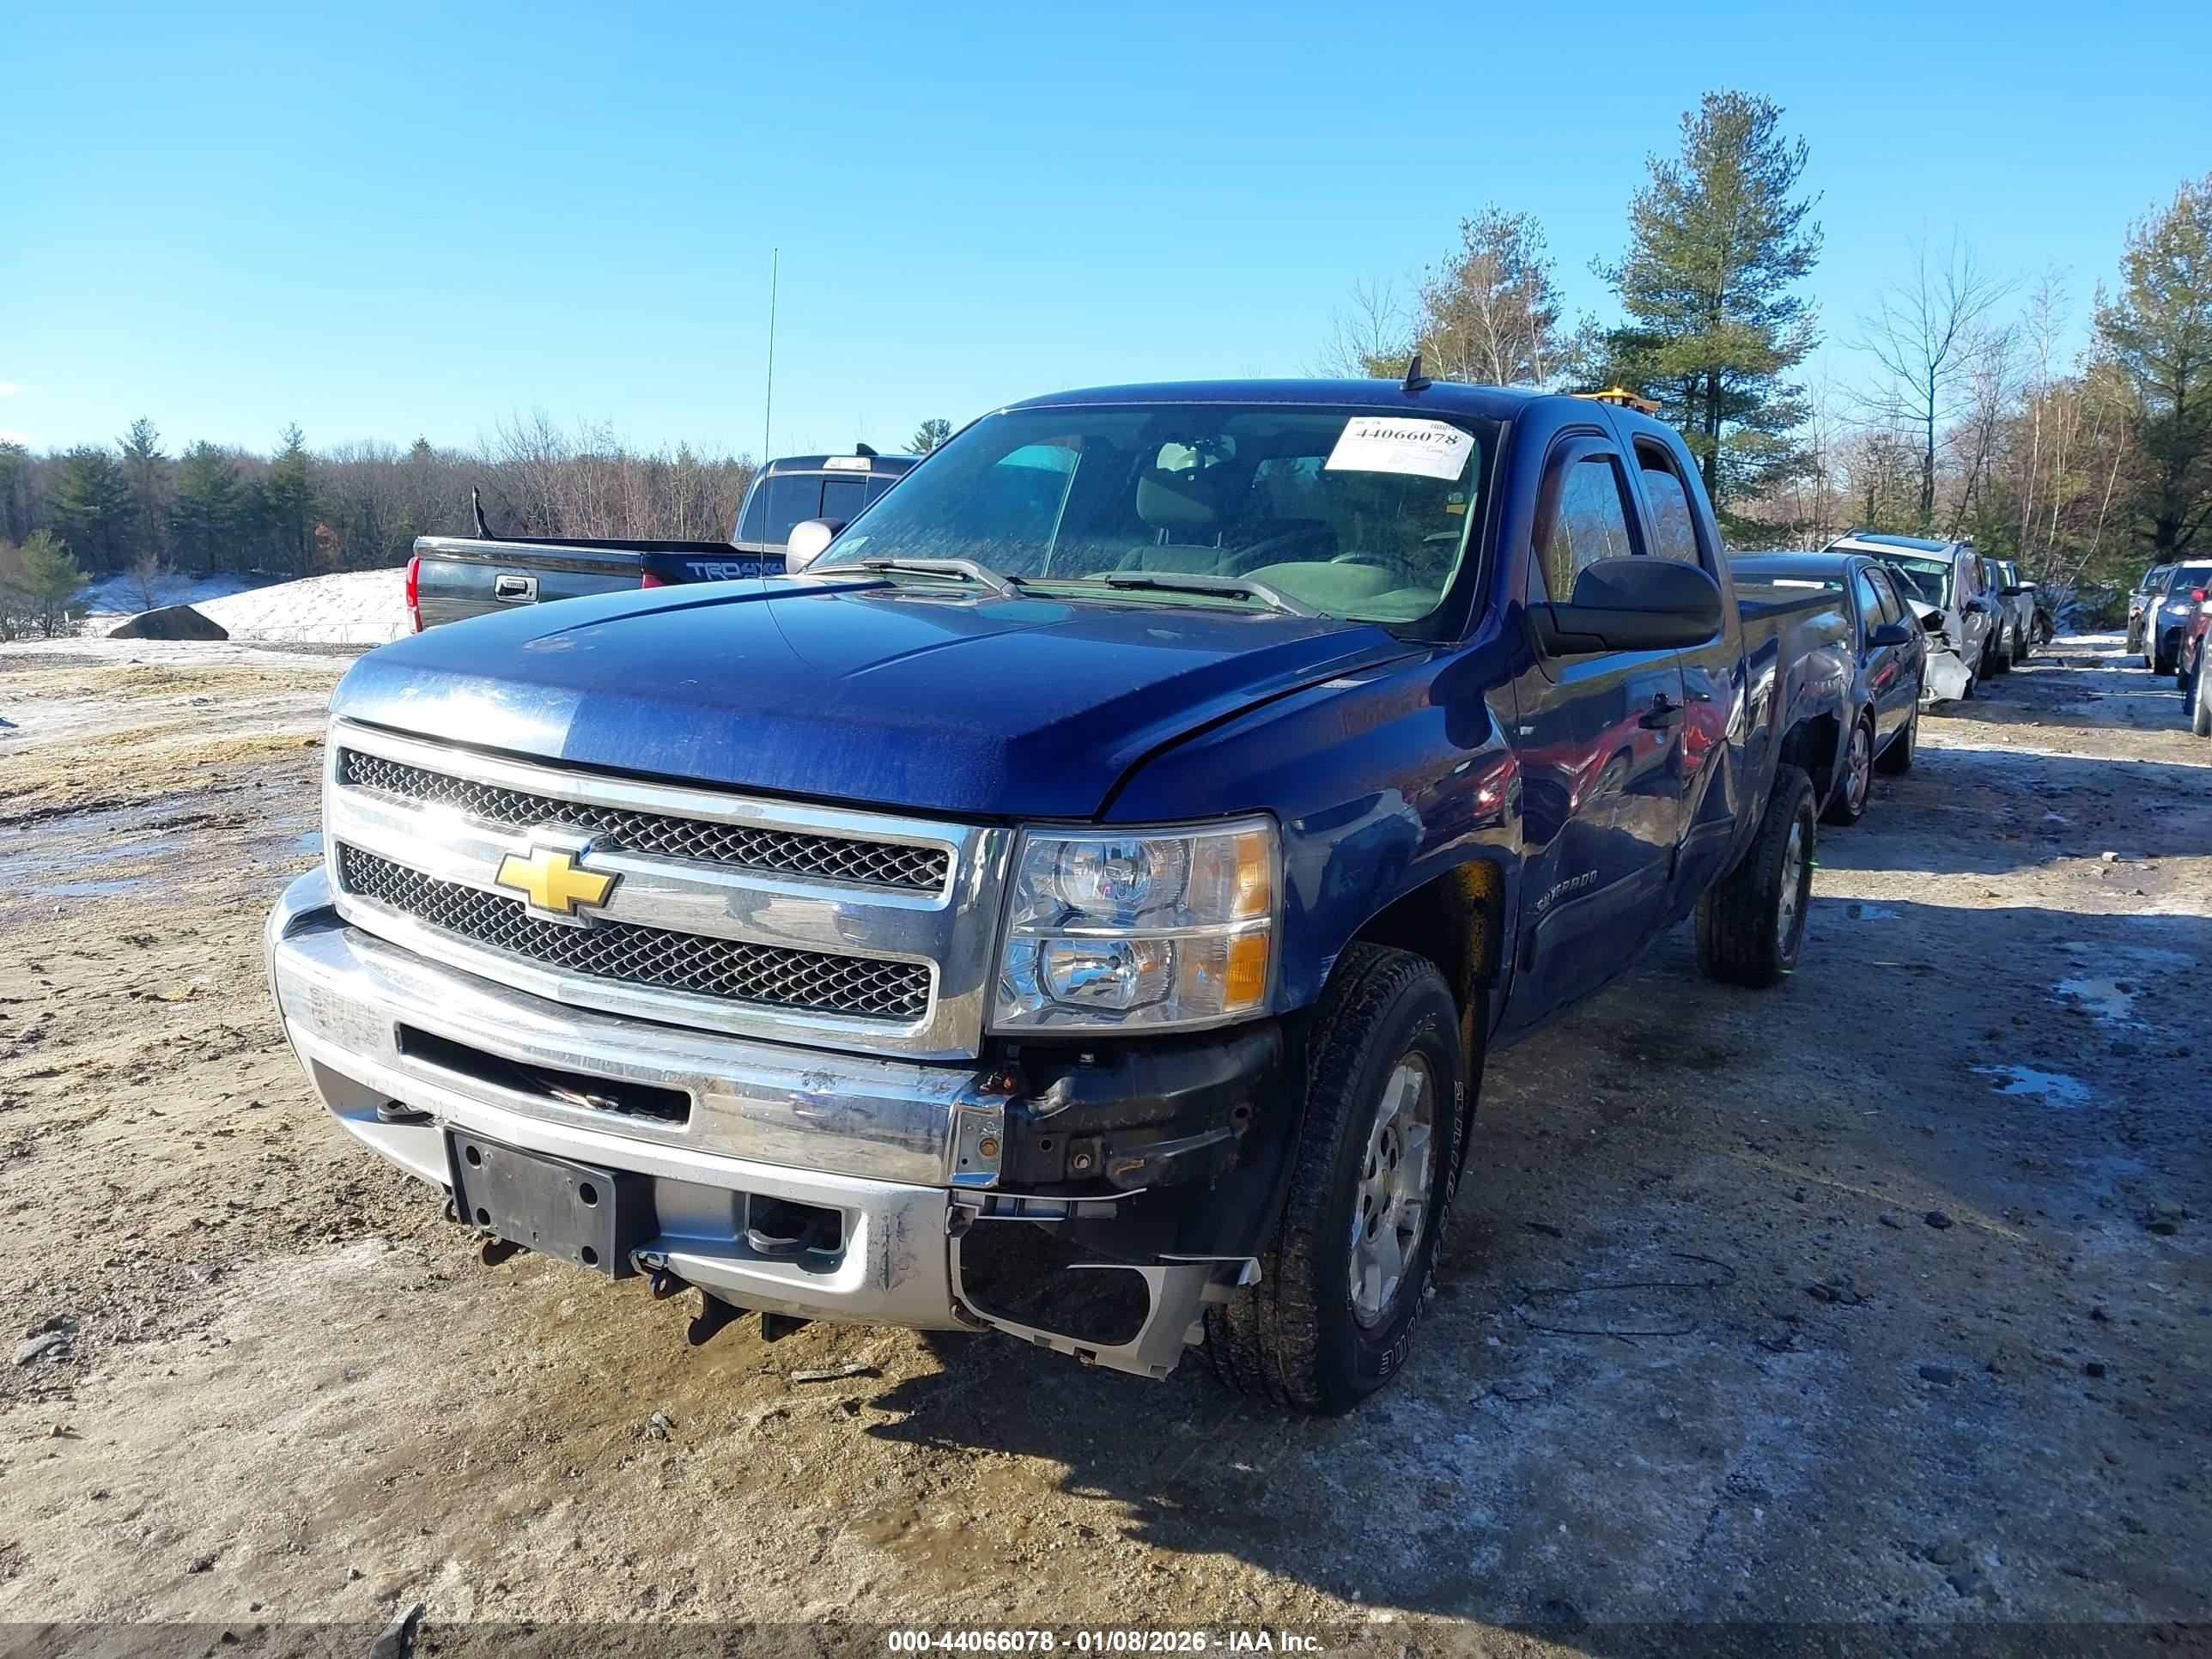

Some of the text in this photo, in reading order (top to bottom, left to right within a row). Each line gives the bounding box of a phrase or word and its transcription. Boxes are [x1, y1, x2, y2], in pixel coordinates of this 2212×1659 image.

[1355, 428, 1458, 446] 44066078
[685, 562, 743, 580] TRD
[1535, 869, 1598, 913] SILVERADO
